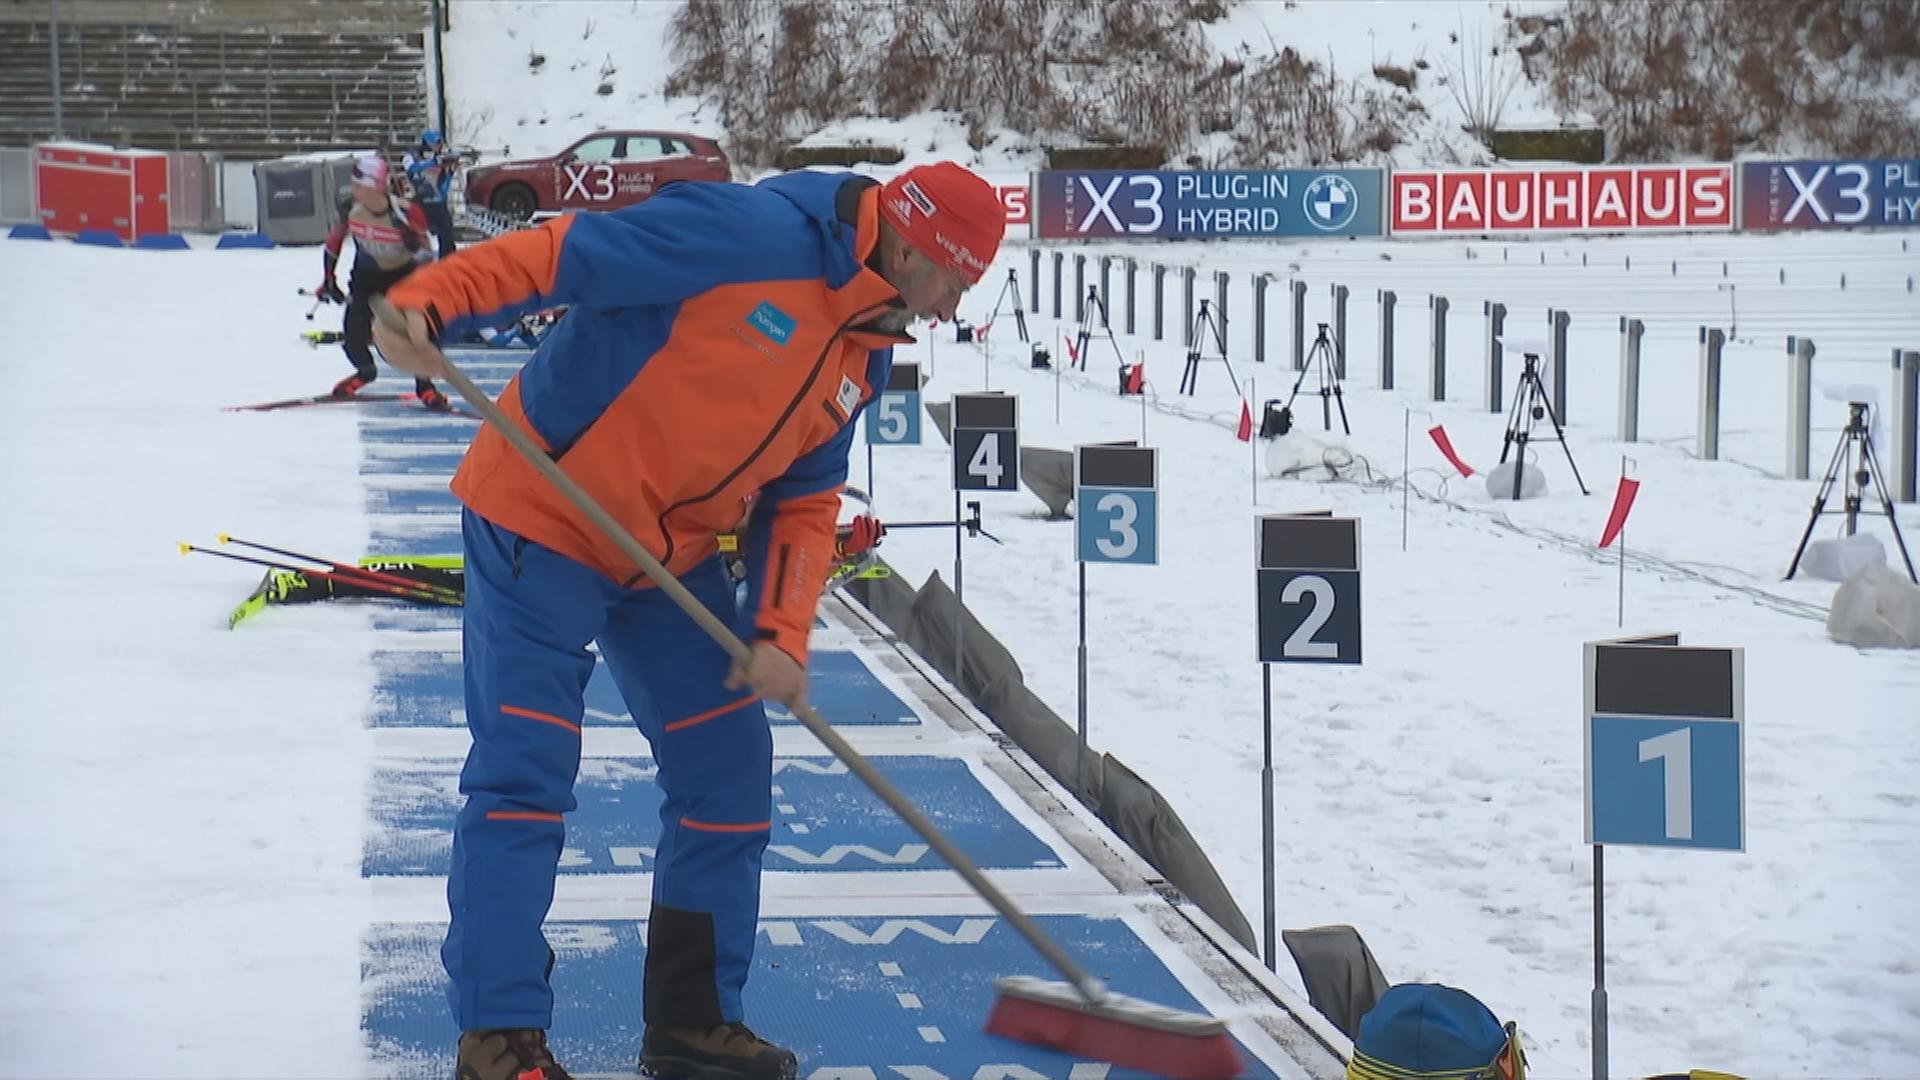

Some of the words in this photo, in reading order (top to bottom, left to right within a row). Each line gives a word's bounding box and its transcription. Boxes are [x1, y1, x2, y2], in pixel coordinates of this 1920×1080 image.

[563, 165, 615, 201] X3
[1078, 175, 1164, 233] X3
[1178, 174, 1289, 199] PLUG-IN
[1400, 176, 1725, 223] BAUHAUS
[1783, 163, 1870, 223] X3
[1178, 207, 1279, 232] HYBRID
[878, 393, 909, 441] 5
[967, 432, 1004, 488] 4
[1095, 492, 1139, 559] 3
[1281, 574, 1339, 659] 2
[1639, 726, 1693, 841] 1
